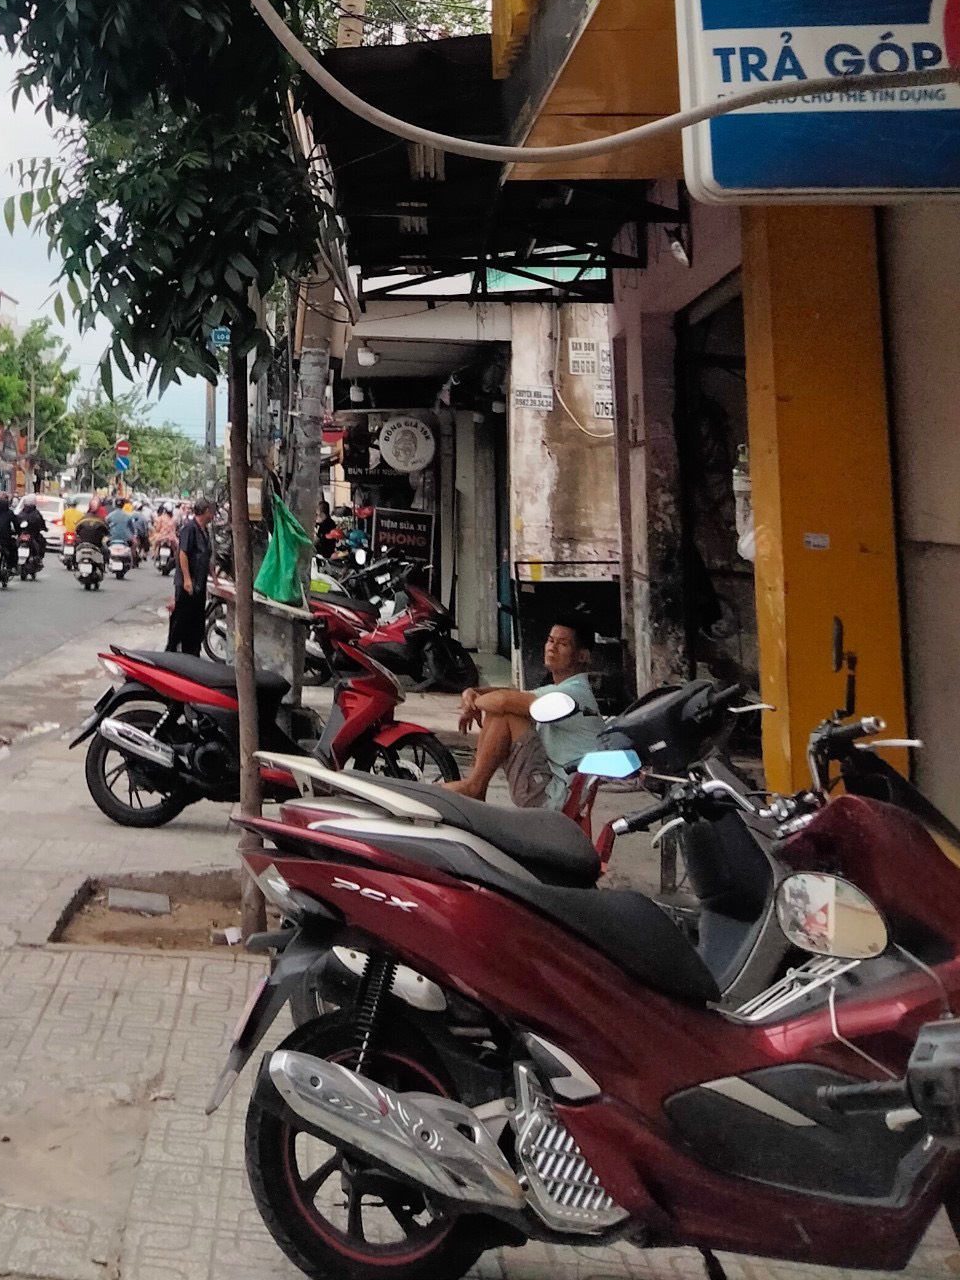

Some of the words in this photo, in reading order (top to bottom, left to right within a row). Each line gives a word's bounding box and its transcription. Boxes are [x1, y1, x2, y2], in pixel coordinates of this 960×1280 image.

[712, 31, 808, 83] TRẢ
[824, 31, 943, 77] GÓP
[417, 523, 427, 532] XE
[331, 876, 419, 913] PCX
